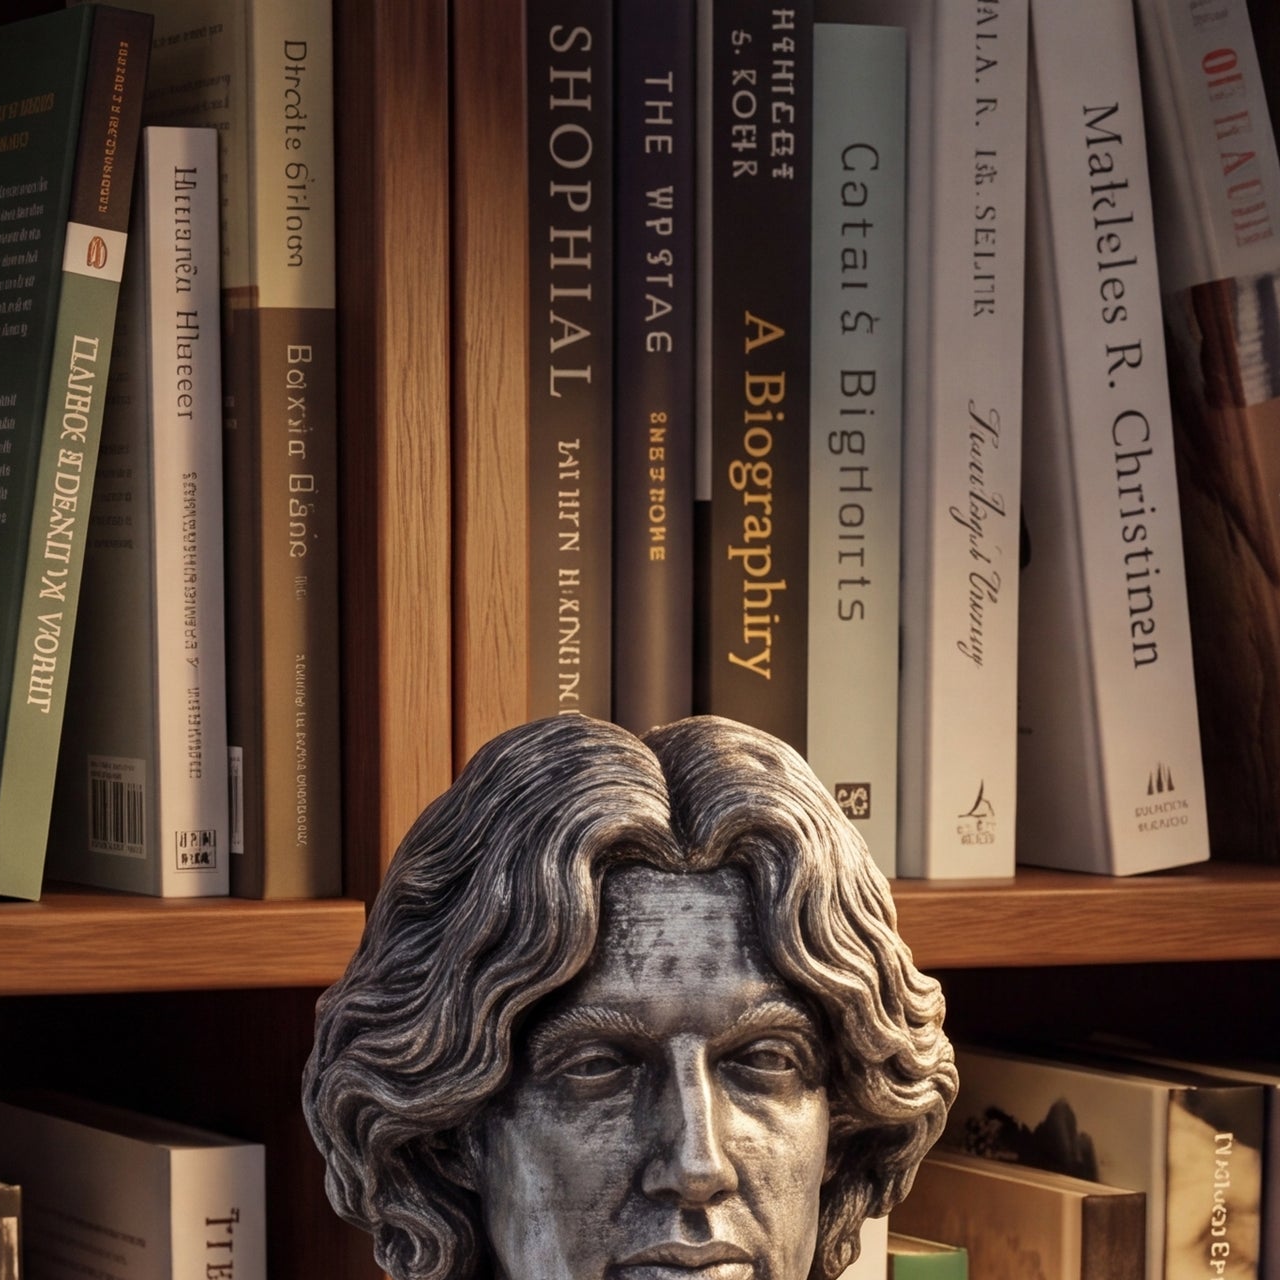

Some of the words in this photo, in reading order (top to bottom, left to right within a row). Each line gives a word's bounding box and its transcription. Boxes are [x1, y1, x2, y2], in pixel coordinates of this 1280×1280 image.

[645, 72, 673, 154] THE
[550, 25, 592, 398] SHOPHIAL
[745, 311, 785, 354] A
[1106, 340, 1143, 388] R.
